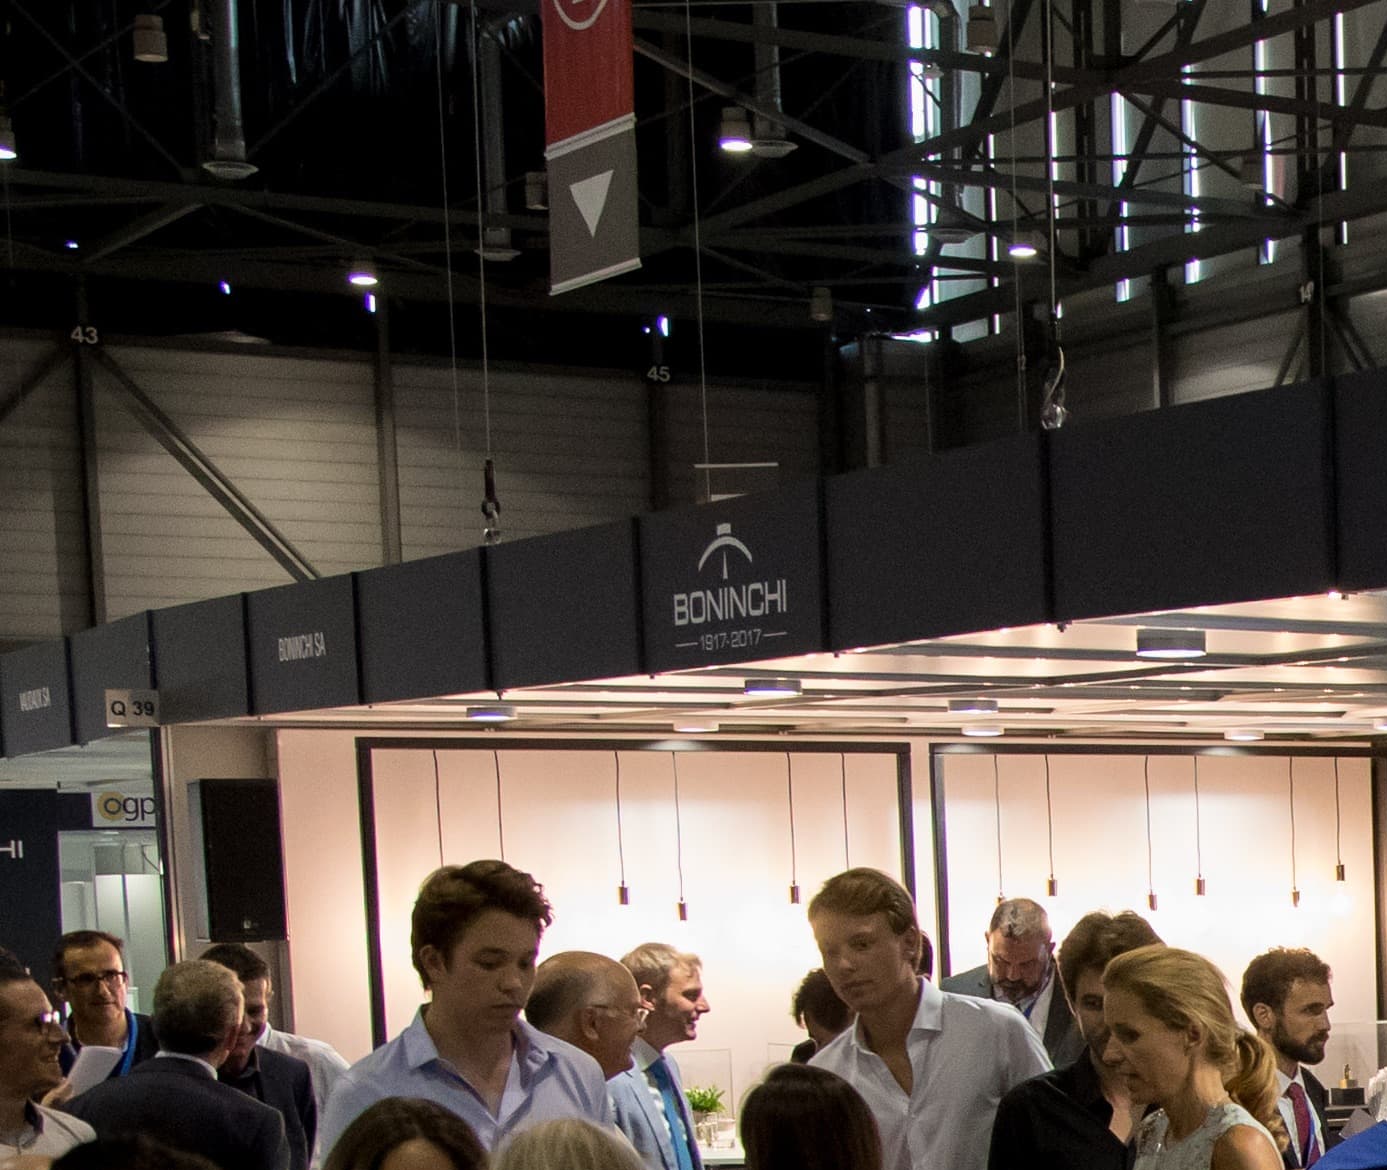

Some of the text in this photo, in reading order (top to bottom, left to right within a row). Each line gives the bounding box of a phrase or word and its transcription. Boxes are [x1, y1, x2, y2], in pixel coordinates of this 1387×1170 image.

[71, 326, 98, 345] 43
[647, 366, 670, 382] 45
[673, 579, 787, 626] BONINCHI
[314, 631, 326, 657] SA
[700, 628, 762, 651] 1917-2017
[111, 701, 154, 717] Q 39
[104, 797, 156, 821] ogp
